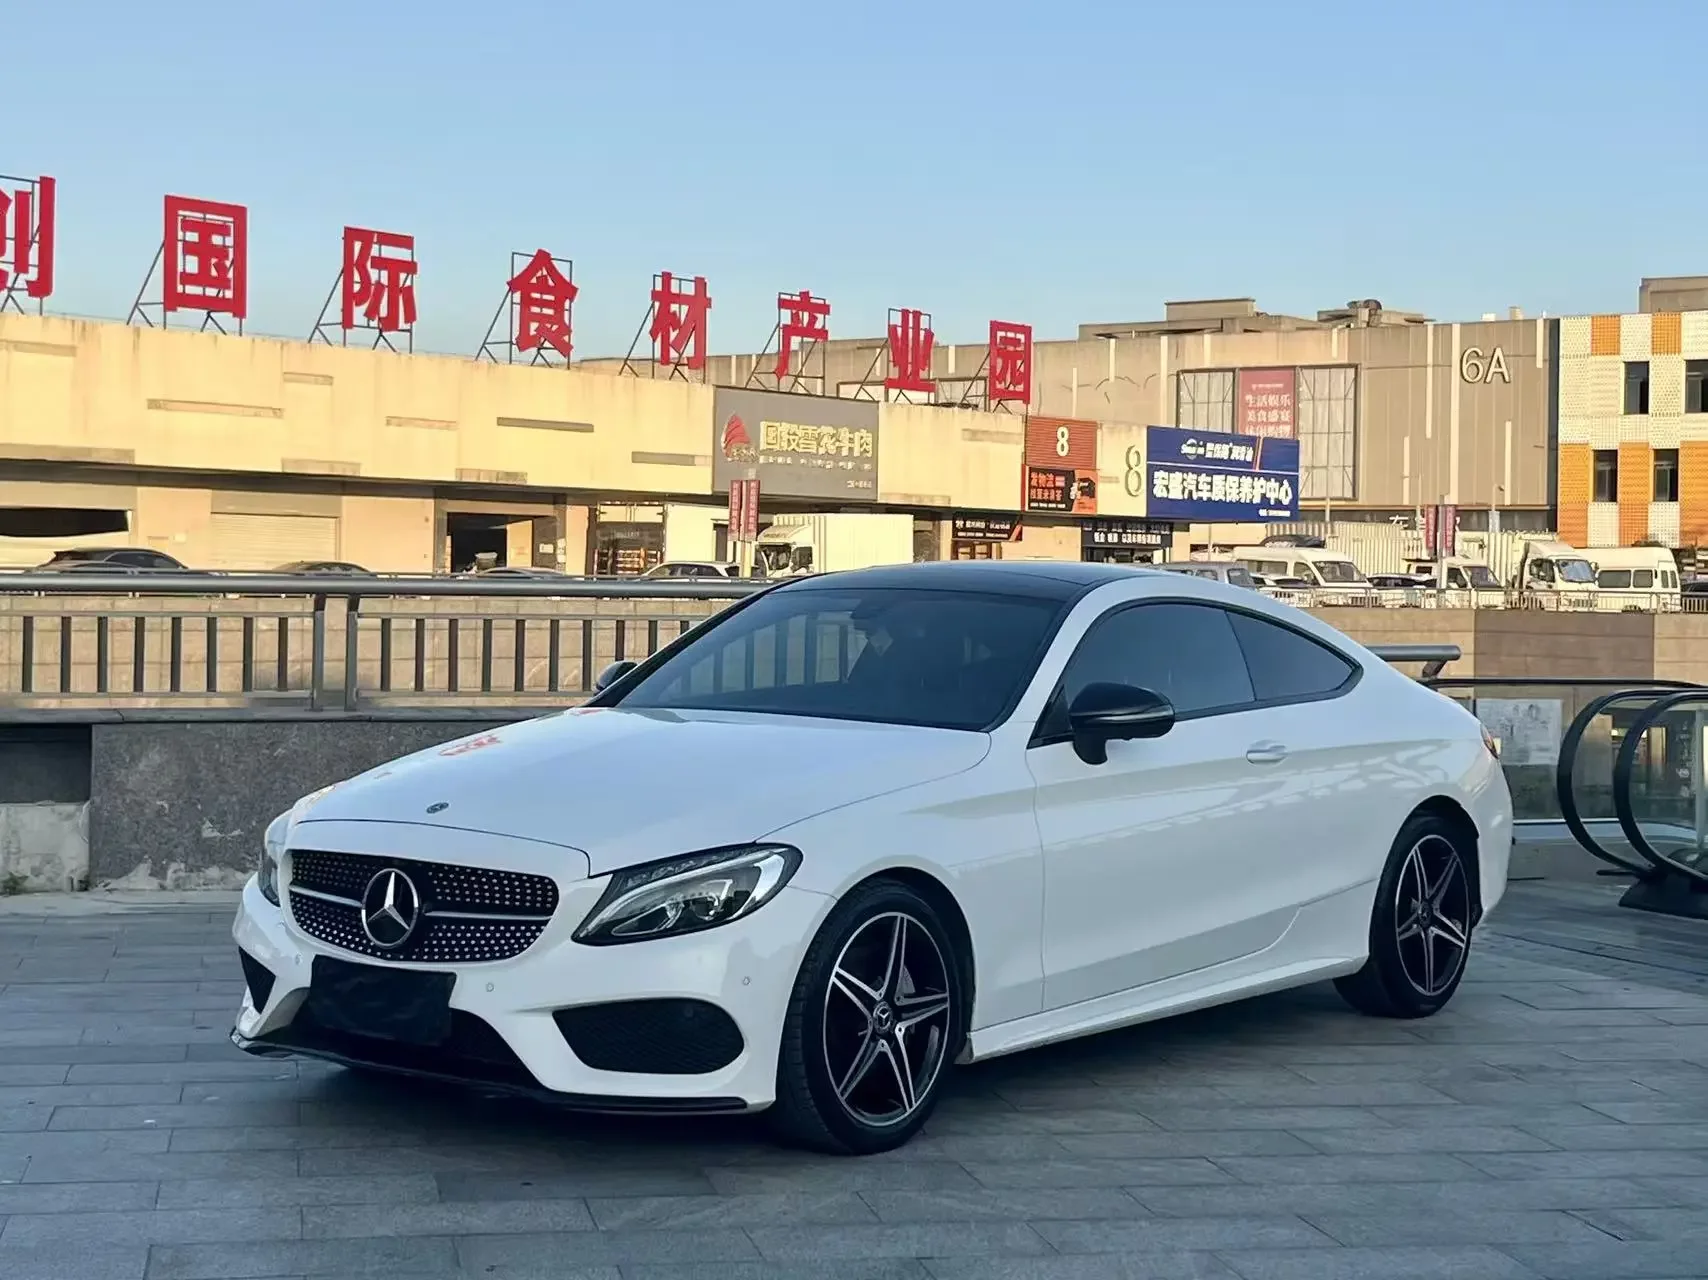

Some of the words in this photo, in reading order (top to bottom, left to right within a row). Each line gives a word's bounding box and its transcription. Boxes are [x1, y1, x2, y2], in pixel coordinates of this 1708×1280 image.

[1460, 346, 1512, 384] 6A
[1056, 426, 1069, 457] 8
[1124, 444, 1142, 498] 8
